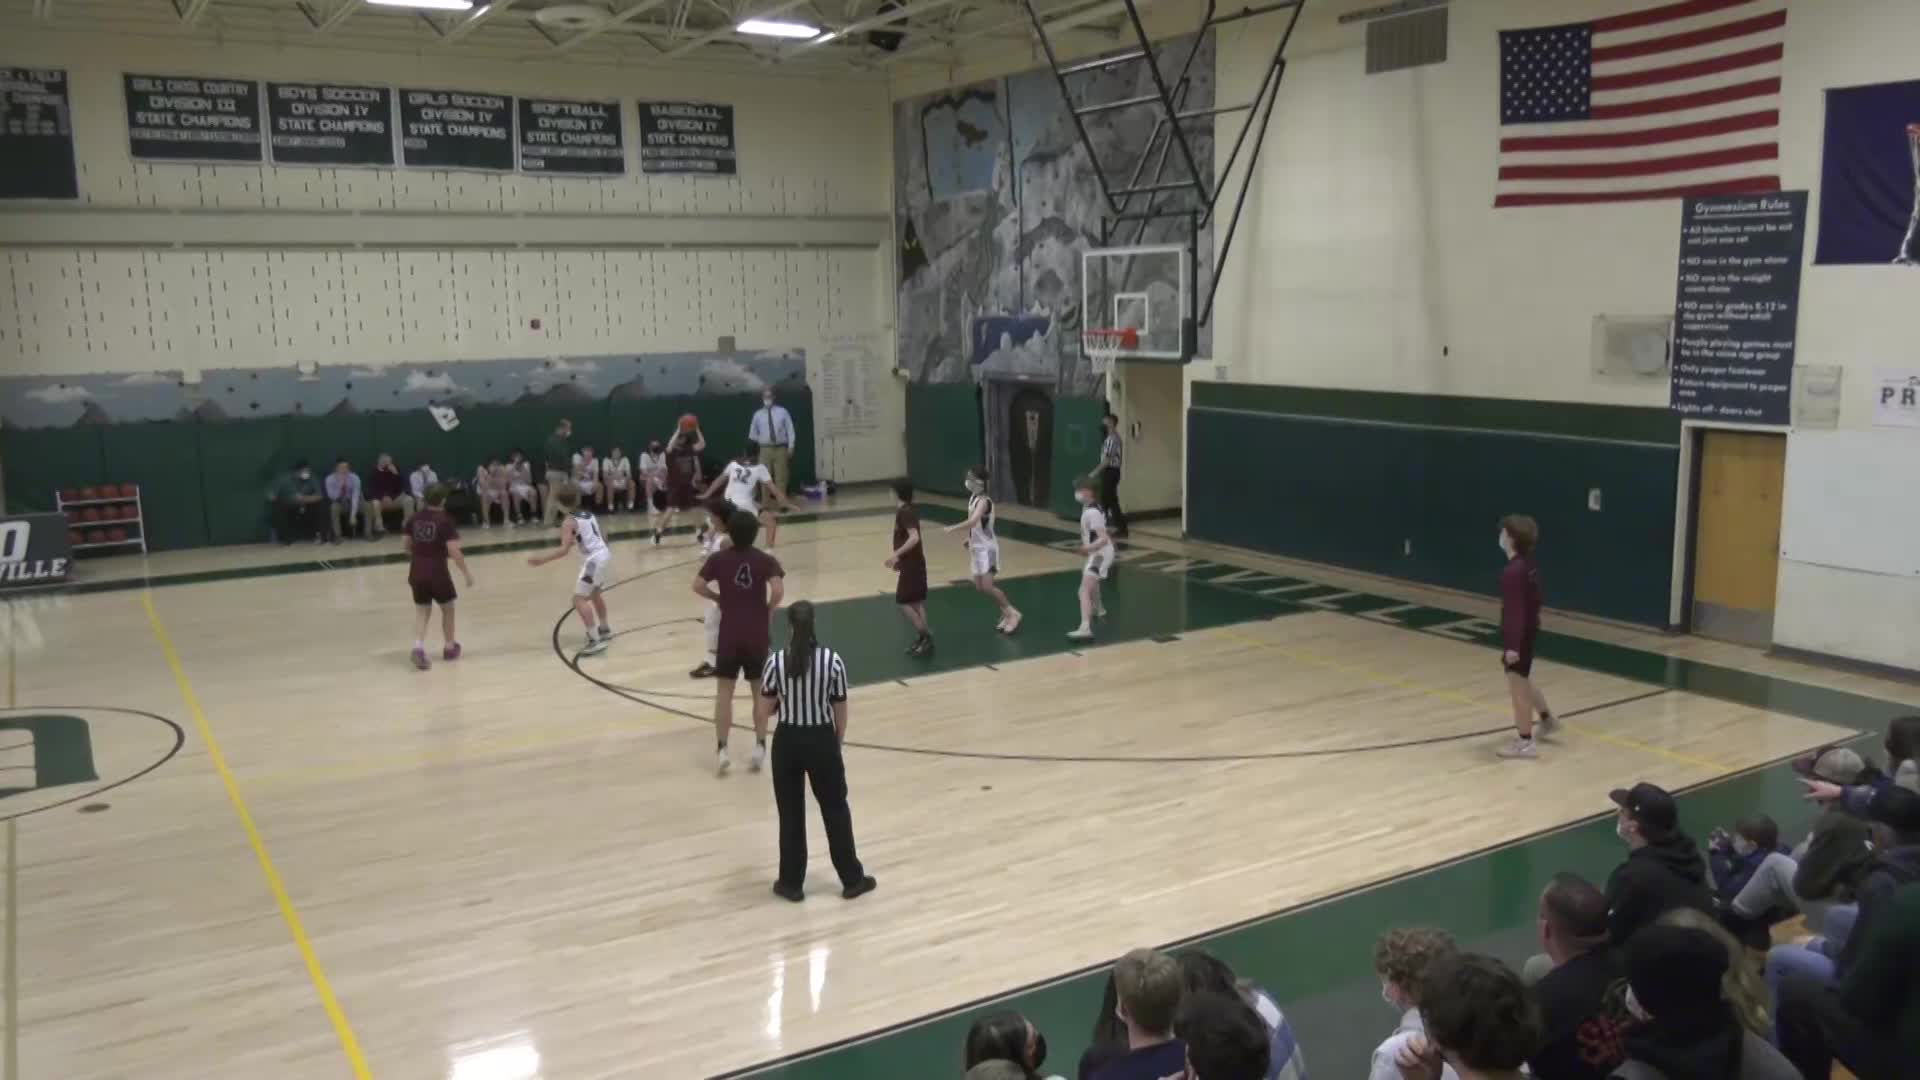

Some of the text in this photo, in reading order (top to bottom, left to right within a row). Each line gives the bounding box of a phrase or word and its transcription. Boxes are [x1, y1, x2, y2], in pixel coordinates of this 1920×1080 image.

[278, 87, 380, 102] BOYS SOCCER
[148, 95, 212, 111] DIVISION
[291, 103, 369, 116] DIVISION IV
[135, 111, 251, 128] STATE CHAMPIONS
[421, 107, 494, 123] DIVISION IV
[279, 117, 384, 134] STATE CHAMPIONS
[409, 122, 507, 140] STATE CHAMPIONS
[538, 117, 604, 131] DIVISION IV
[657, 119, 704, 131] DIVISION
[527, 131, 617, 146] STATE CHAMPIONS
[647, 133, 729, 148] STATE CHAMPIONS
[1695, 198, 1790, 215] Gymnasium Rules
[1686, 257, 1701, 265] NO
[1685, 273, 1700, 282] NO
[1683, 301, 1698, 310] NO
[734, 562, 753, 590] 4
